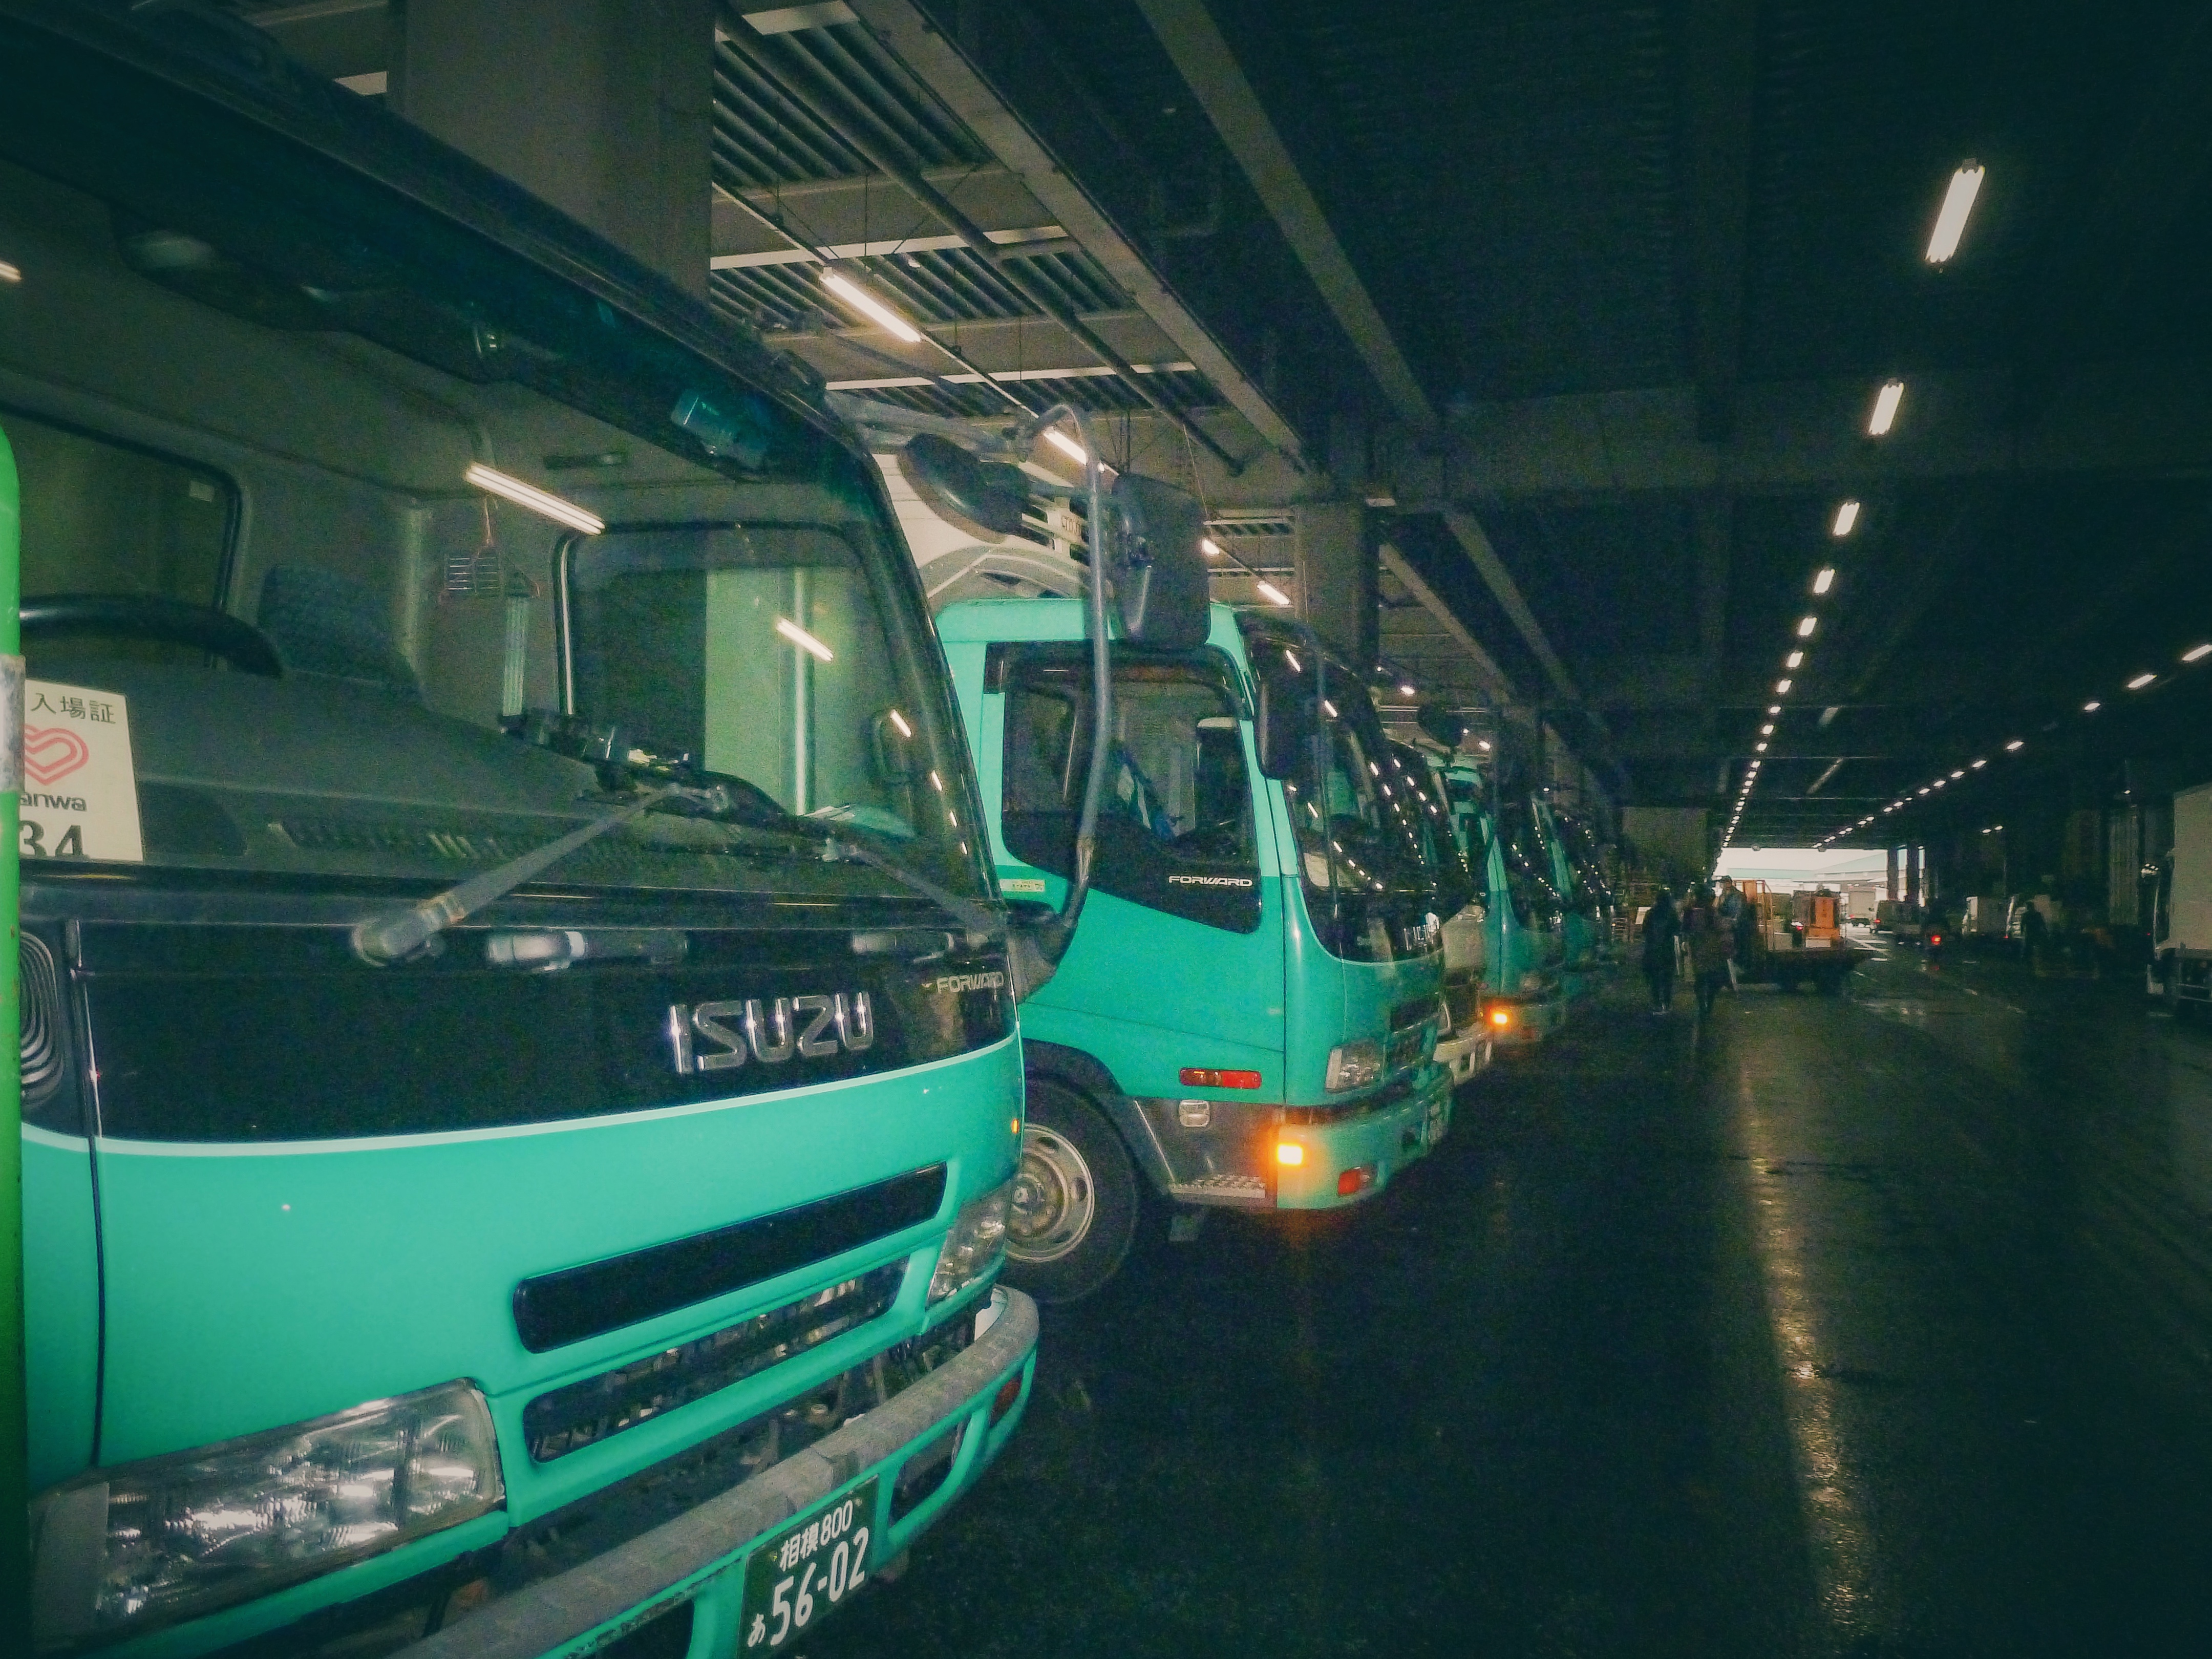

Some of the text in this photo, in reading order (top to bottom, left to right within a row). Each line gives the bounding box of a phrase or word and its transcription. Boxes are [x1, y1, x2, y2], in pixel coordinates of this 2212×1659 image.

[31, 693, 116, 724] 入場証
[1168, 875, 1253, 887] FORWARD
[937, 971, 1004, 994] FORWARD
[669, 991, 874, 1075] ISUZU
[770, 1527, 869, 1646] 56-02
